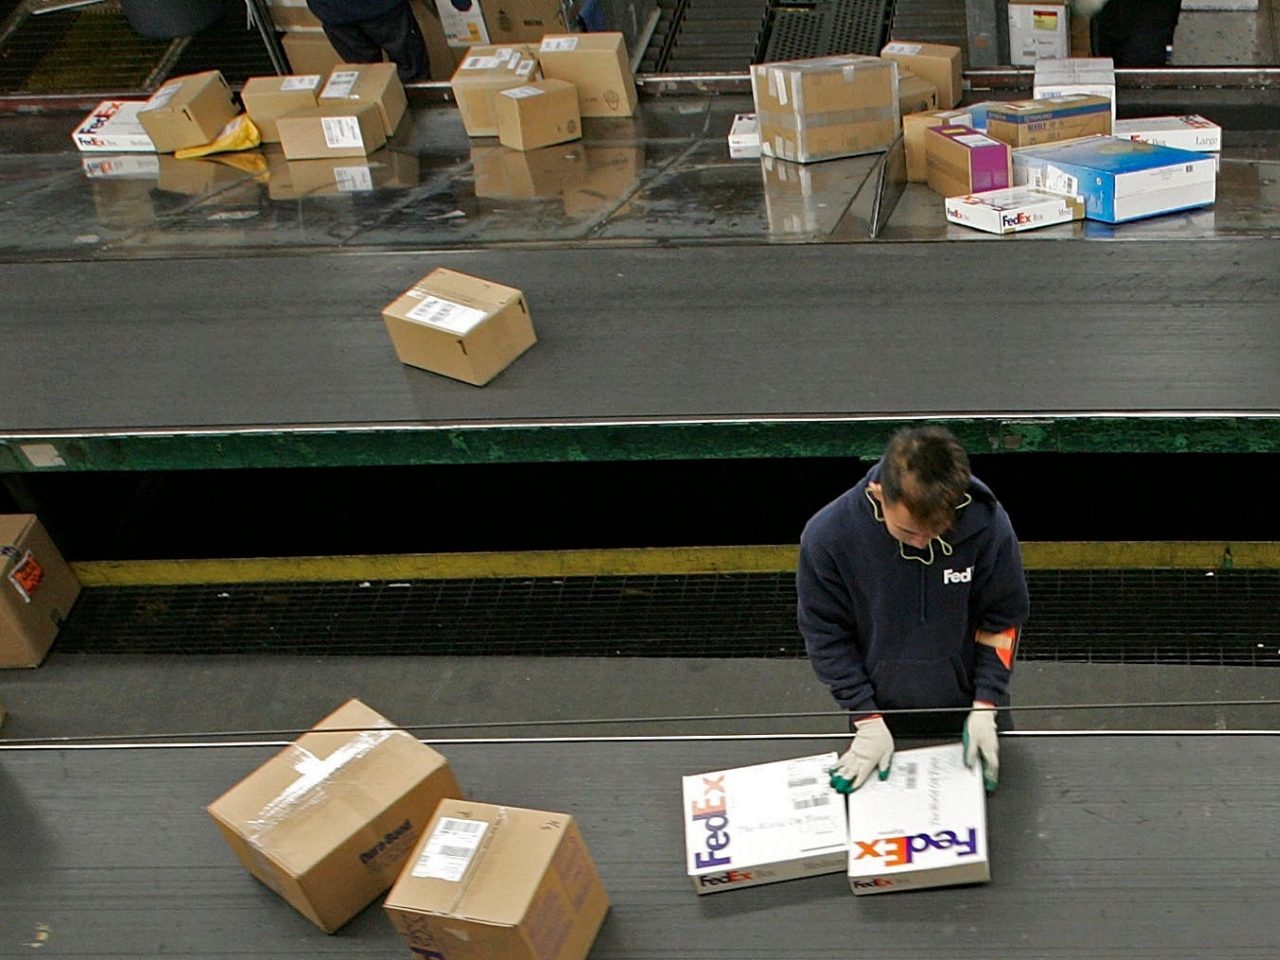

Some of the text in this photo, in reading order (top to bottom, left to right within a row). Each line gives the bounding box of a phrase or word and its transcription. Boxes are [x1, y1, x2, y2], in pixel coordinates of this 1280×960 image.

[78, 102, 122, 134] FedEx
[1002, 212, 1032, 227] FedEx
[943, 567, 971, 585] Fed
[692, 775, 732, 869] FedEx
[854, 827, 977, 867] FedEx
[700, 870, 753, 888] FedEx
[853, 878, 894, 890] FedEx
